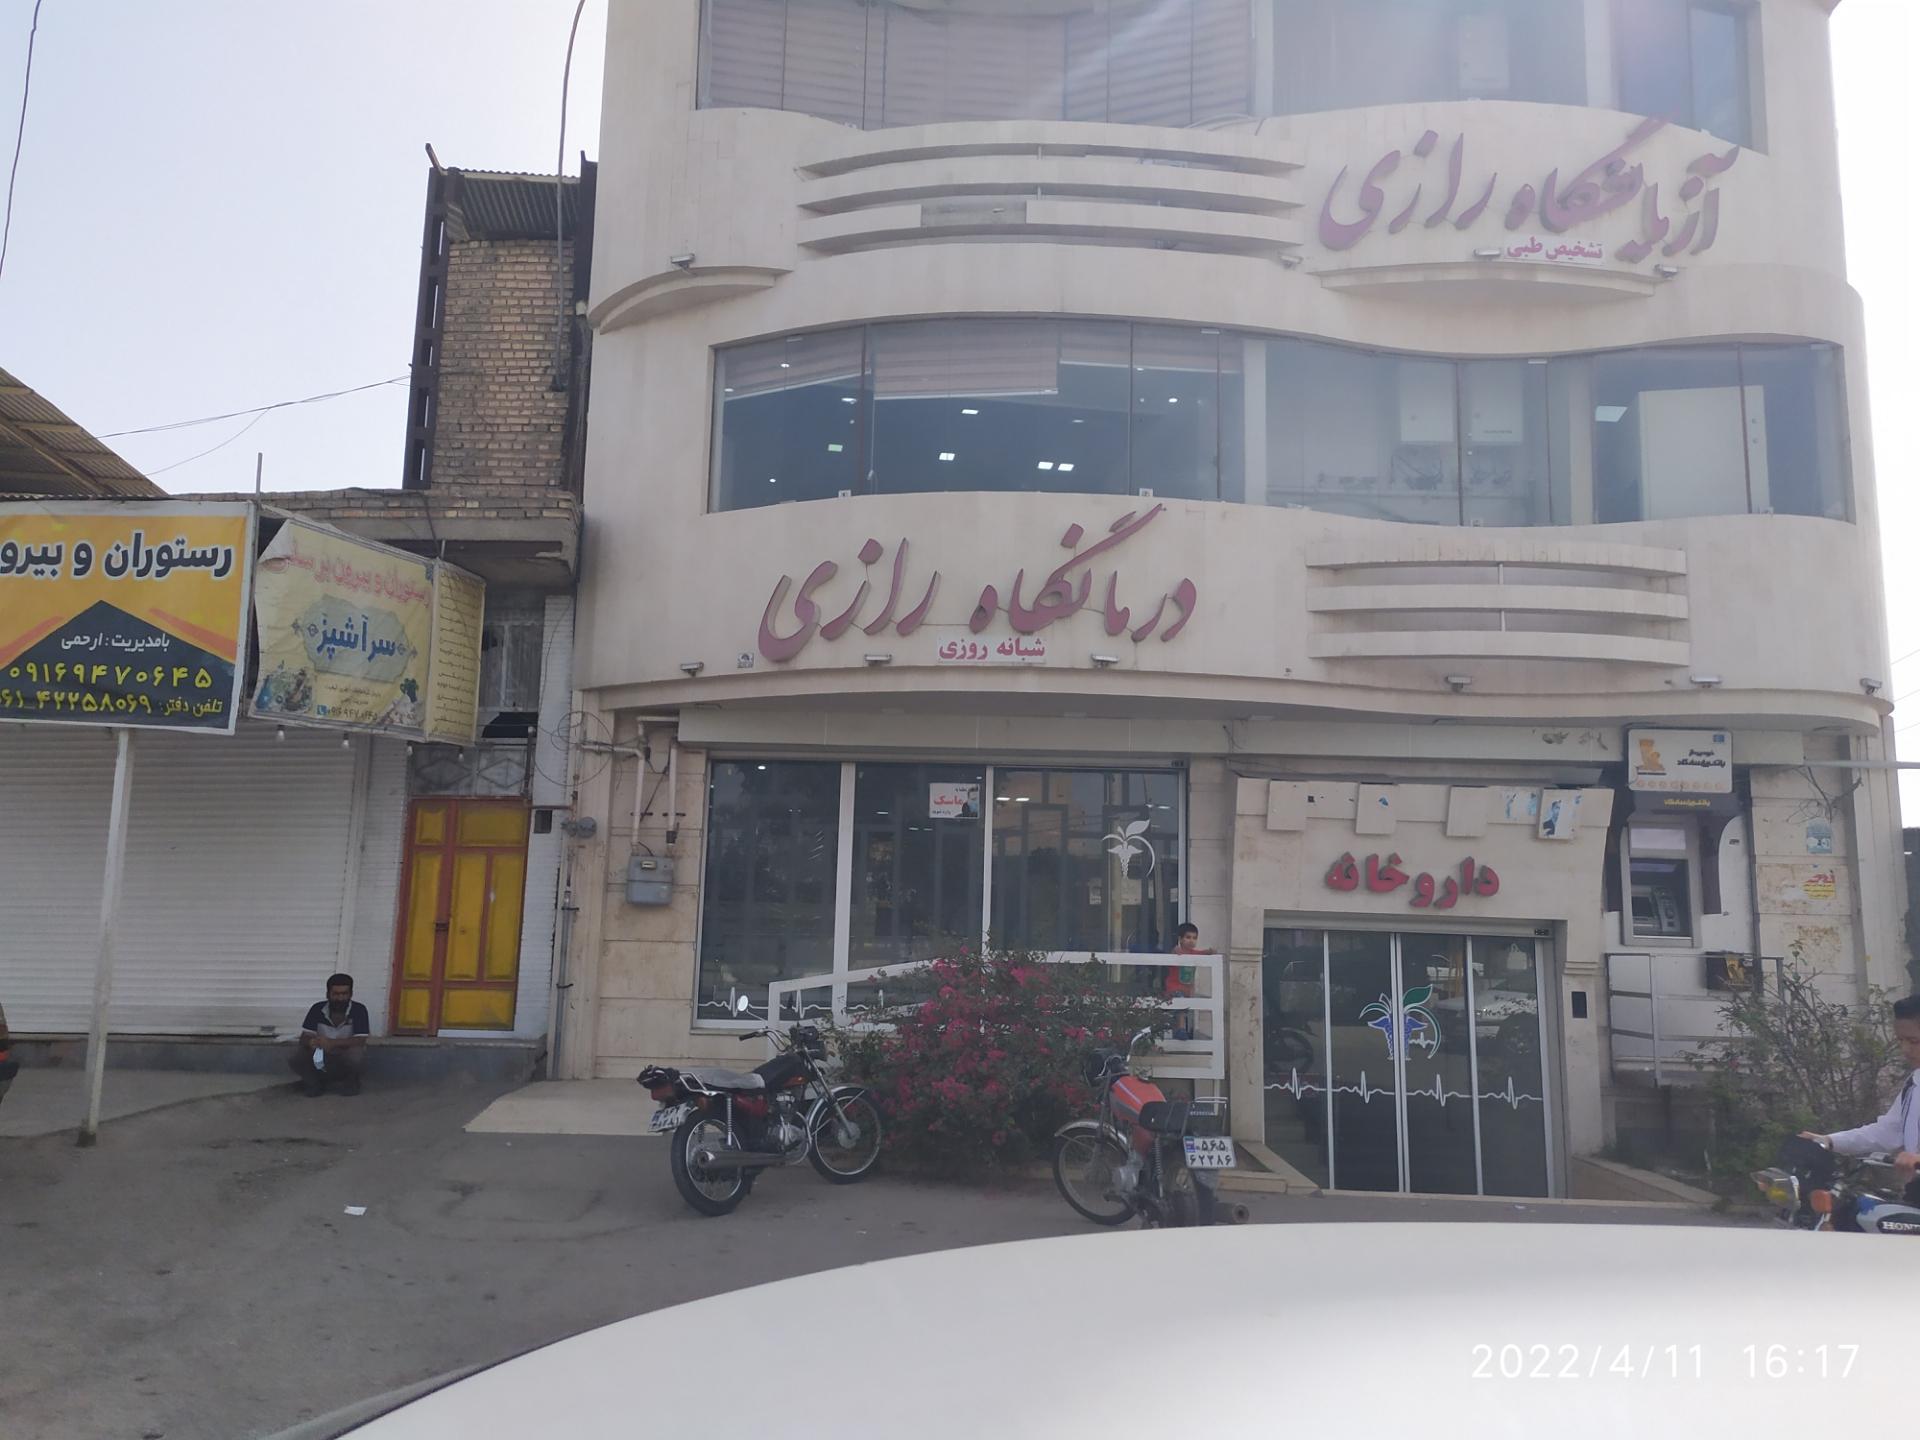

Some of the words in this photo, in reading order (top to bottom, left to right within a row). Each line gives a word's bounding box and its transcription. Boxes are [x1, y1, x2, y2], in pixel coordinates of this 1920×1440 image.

[1318, 129, 1498, 251] رازی
[1504, 116, 1740, 263] آزمایشگاه
[1507, 235, 1543, 258] طبی
[1545, 240, 1602, 260] تشخیص
[73, 542, 93, 576] و
[104, 532, 232, 577] رستوران
[969, 503, 1198, 642] درمانگاه
[758, 537, 940, 662] رازی
[61, 632, 103, 650] ارحمی
[939, 638, 988, 661] روزی
[996, 637, 1045, 661] شبانه
[193, 698, 223, 717] تلفن
[1325, 851, 1500, 910] داروخانه
[1202, 1140, 1226, 1151] ۵۶۵
